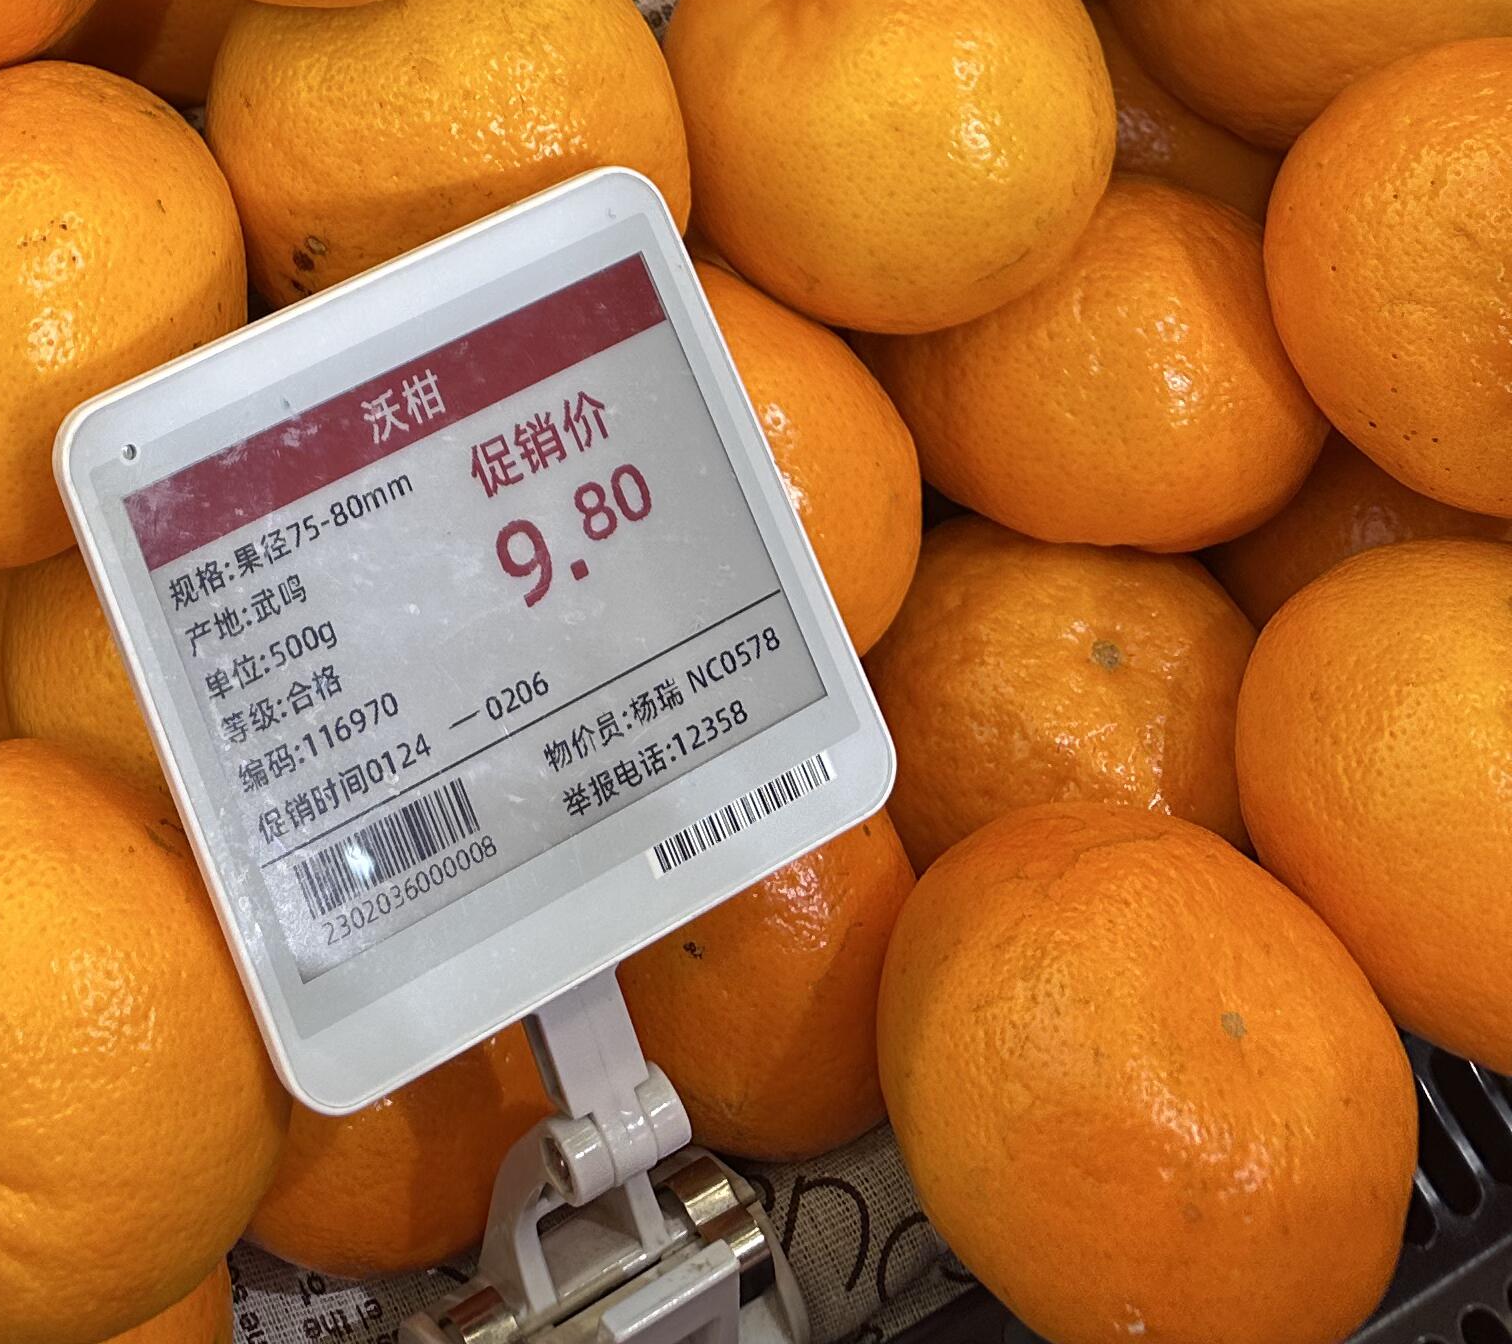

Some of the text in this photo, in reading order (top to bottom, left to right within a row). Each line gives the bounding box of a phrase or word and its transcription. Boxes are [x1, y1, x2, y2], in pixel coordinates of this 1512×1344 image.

[361, 369, 447, 444] 沃柑
[470, 391, 609, 498] 促销价
[169, 473, 413, 611] 规格:果径75-80mm
[495, 464, 652, 608] 9.80
[185, 574, 307, 657] 产地:武鸣
[204, 620, 338, 700] 单位:500g
[221, 665, 342, 743] 等级:合格
[238, 692, 399, 793] 编码:116970
[543, 626, 781, 773] 物价员:杨瑞 NC0578
[258, 733, 432, 845] 促销时间0124
[563, 699, 748, 816] 举报电话:12358
[322, 834, 498, 946] 2302036000008
